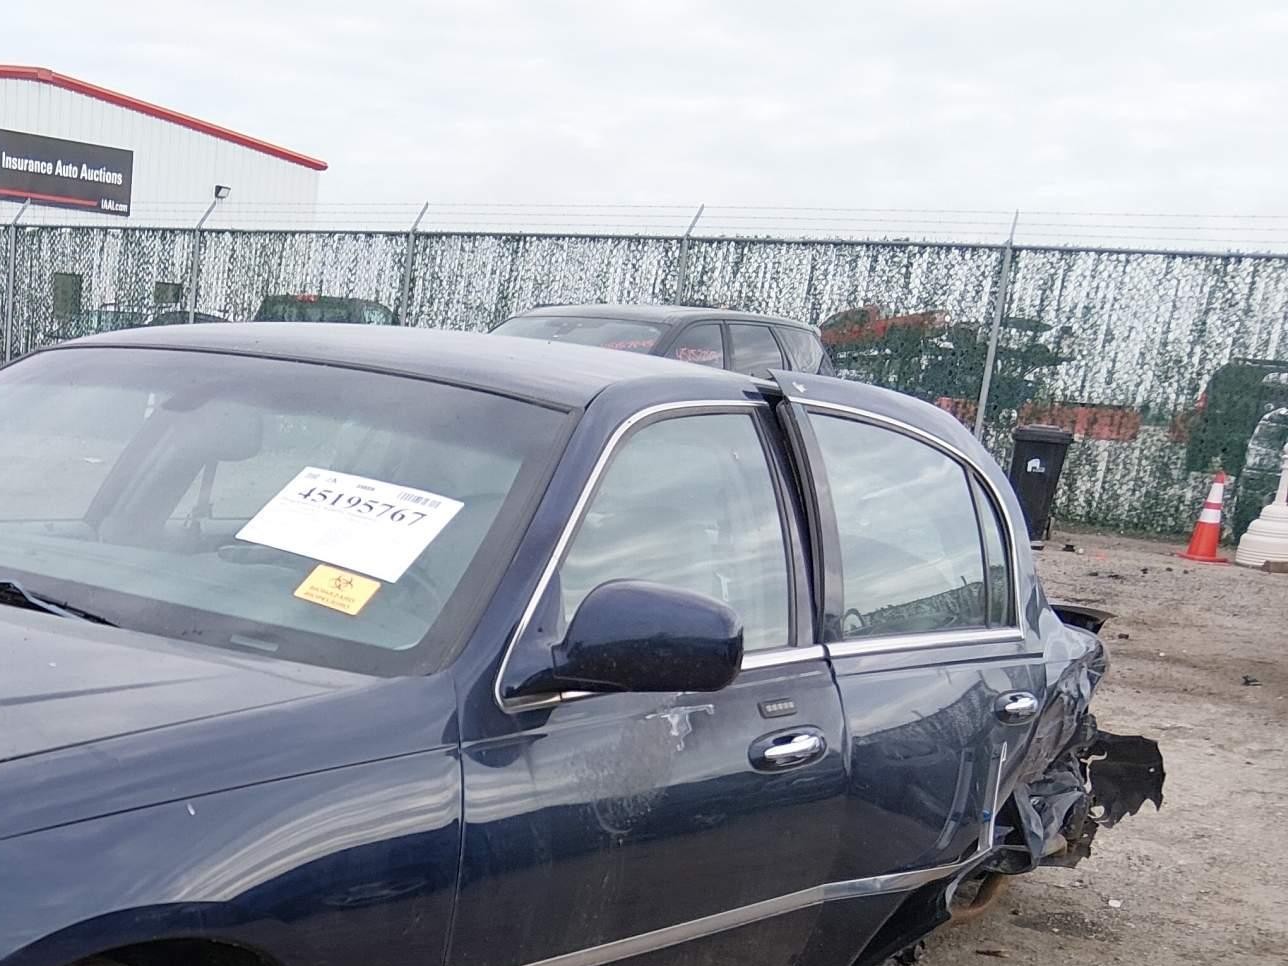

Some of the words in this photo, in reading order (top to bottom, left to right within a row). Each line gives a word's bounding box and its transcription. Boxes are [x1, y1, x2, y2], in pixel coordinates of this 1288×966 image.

[1, 151, 53, 175] Insurance
[54, 159, 78, 179] Auto
[79, 163, 123, 186] Auctions
[298, 487, 428, 527] 45195767
